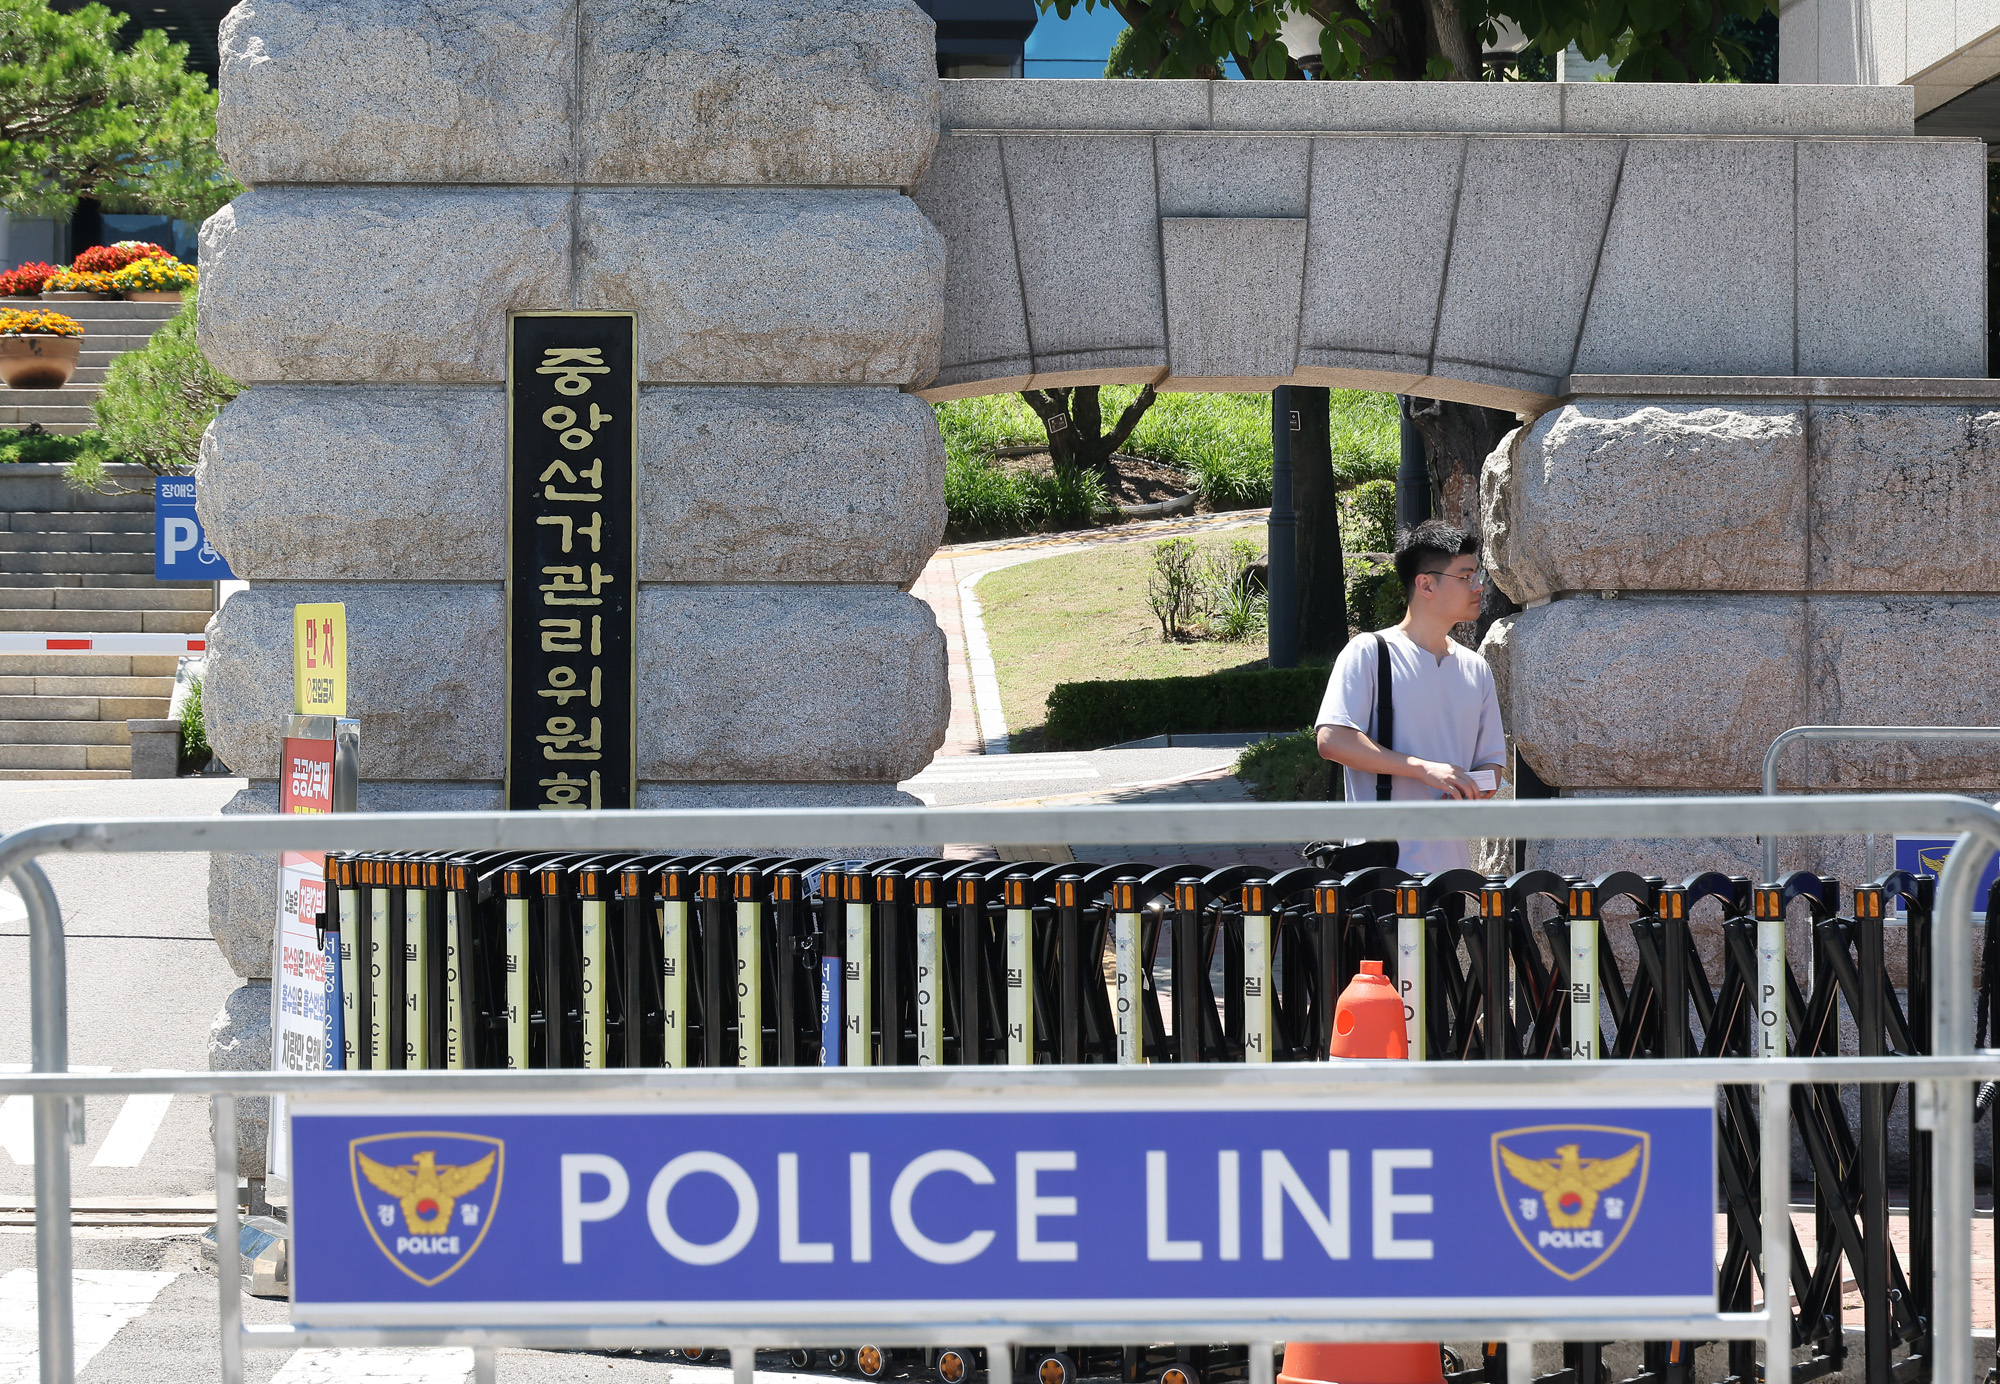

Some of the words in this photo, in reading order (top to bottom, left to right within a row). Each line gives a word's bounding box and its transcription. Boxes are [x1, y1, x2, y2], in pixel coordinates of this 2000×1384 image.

[164, 517, 199, 565] P
[536, 347, 614, 810] 중앙선거관리위원회
[292, 757, 331, 801] 공공2부제
[738, 959, 748, 1067] POLIC
[281, 1028, 305, 1071] 차량만
[561, 1150, 1079, 1267] POLICE
[1145, 1148, 1435, 1261] LINE
[396, 1236, 460, 1254] POLICE
[1538, 1230, 1604, 1249] POLICE
